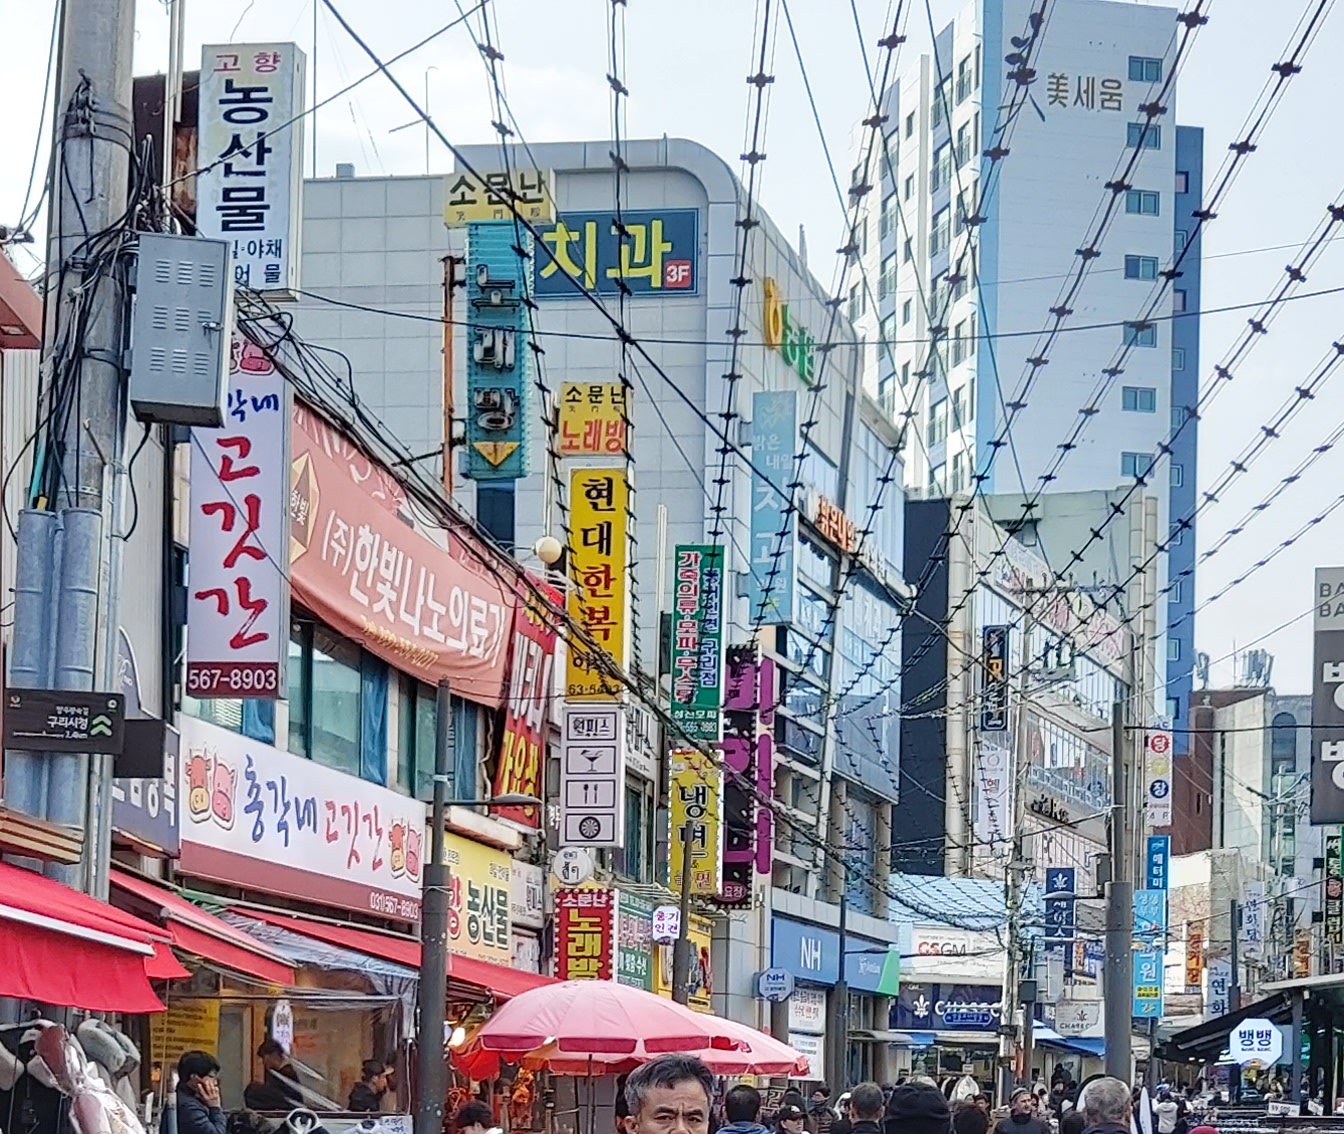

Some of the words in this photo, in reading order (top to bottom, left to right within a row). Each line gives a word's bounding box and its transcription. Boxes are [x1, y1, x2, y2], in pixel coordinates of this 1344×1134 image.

[214, 53, 282, 72] 고향
[1047, 73, 1123, 112] 美세움
[216, 78, 274, 232] 농산물
[449, 172, 545, 205] 소문난
[539, 219, 672, 289] 치과
[666, 263, 691, 282] 3F
[565, 385, 627, 404] 소문난
[561, 419, 626, 452] 노래방
[195, 436, 269, 651] 고깃간
[580, 476, 617, 642] 현대한복
[189, 668, 277, 691] 567-8903
[244, 753, 319, 847] 총각네
[325, 800, 383, 871] 고깃간
[466, 879, 508, 949] 농산물
[561, 890, 606, 908] 소문난
[567, 909, 605, 979] 노래방
[800, 935, 822, 971] NH
[767, 974, 785, 982] NH
[1239, 1029, 1272, 1047] 뱅뱅
